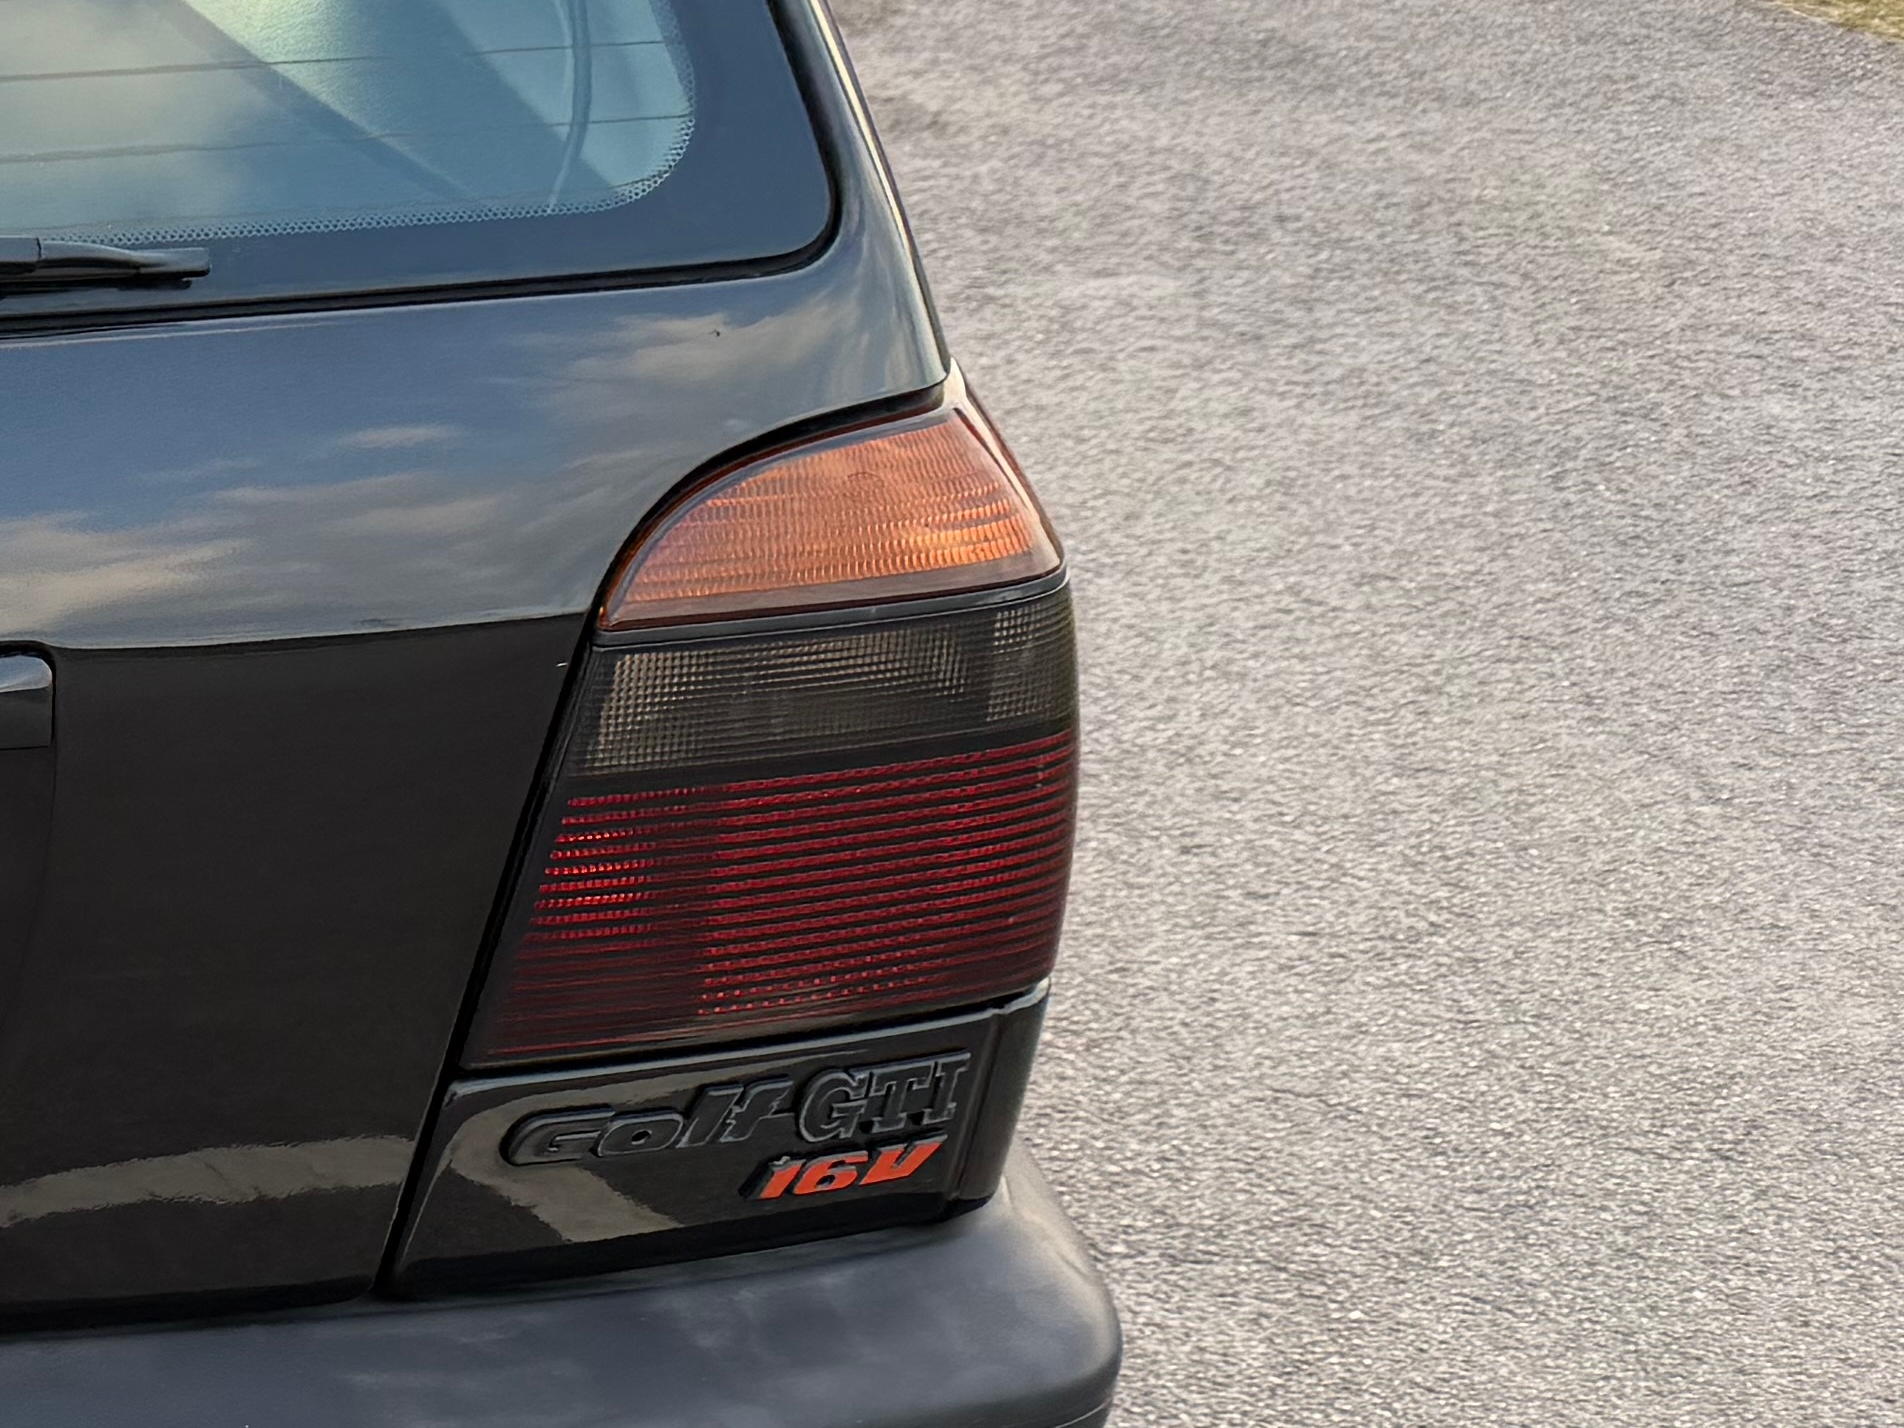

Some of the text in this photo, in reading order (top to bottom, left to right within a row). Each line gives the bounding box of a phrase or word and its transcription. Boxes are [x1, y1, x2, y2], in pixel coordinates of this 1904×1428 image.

[500, 1050, 972, 1166] Golf GTI
[748, 1133, 948, 1200] 16V
